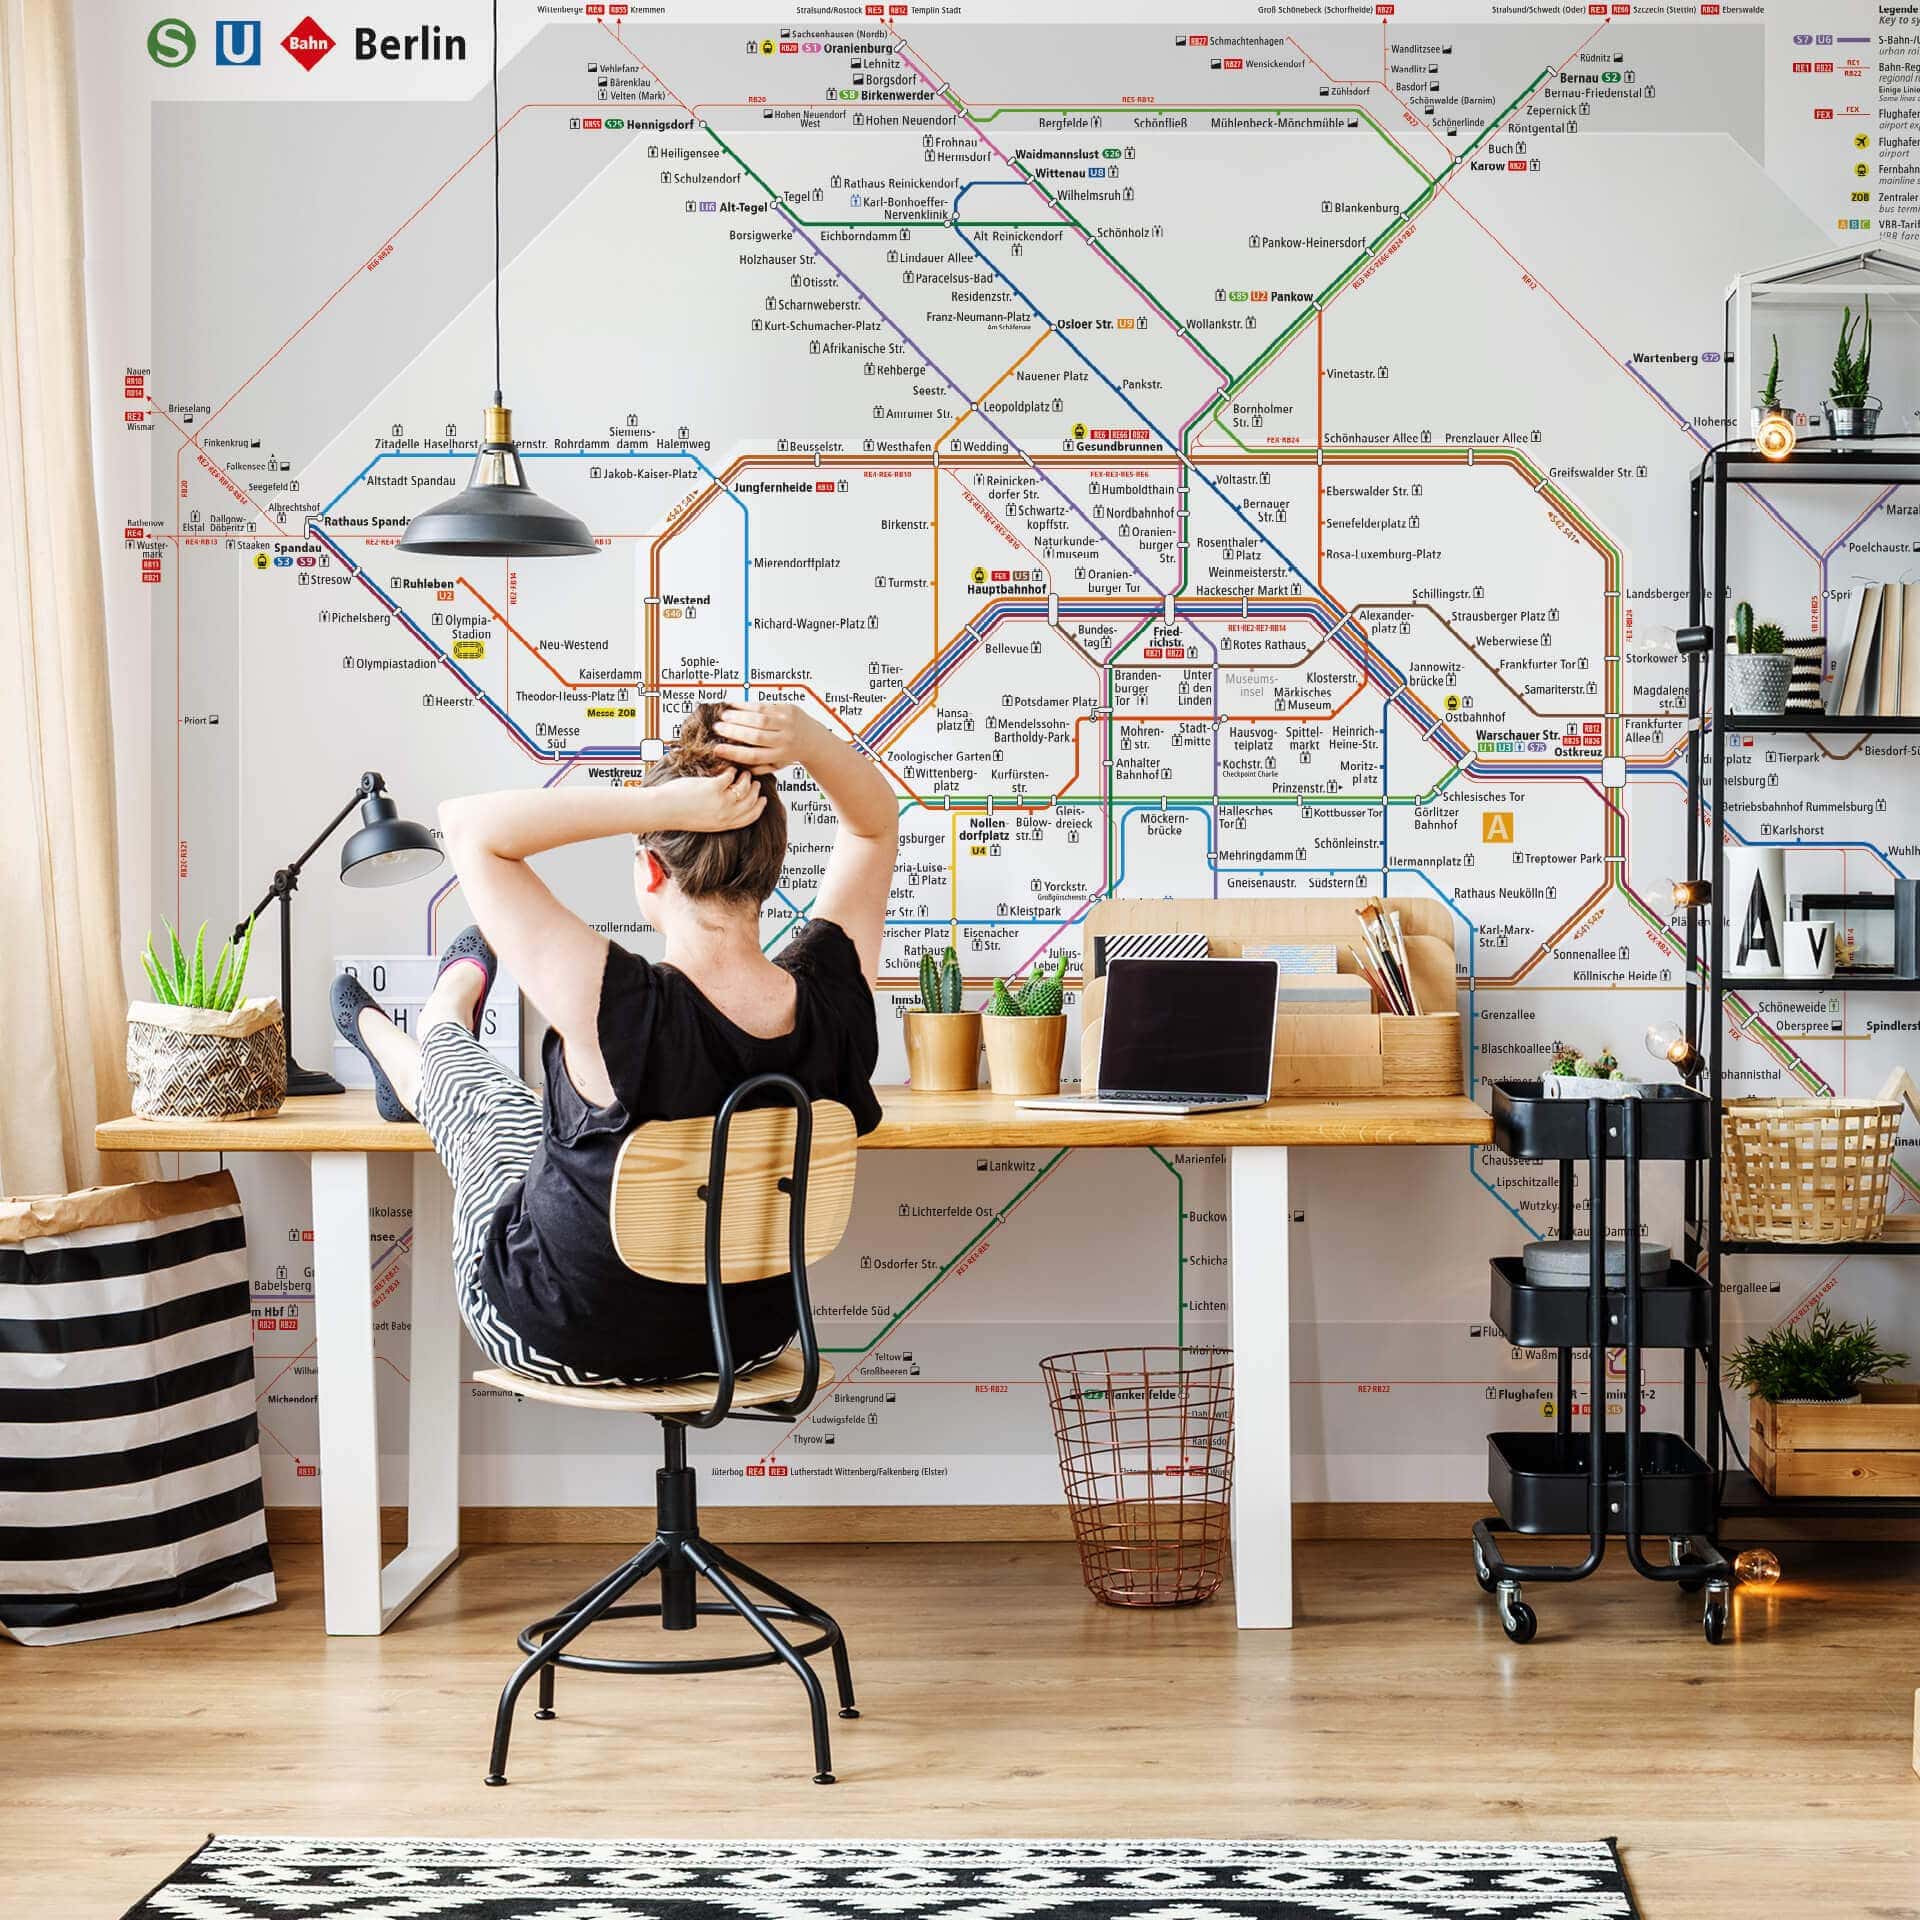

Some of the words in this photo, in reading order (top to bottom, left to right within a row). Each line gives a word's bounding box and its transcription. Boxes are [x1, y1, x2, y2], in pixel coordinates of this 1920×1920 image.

[1879, 5, 1918, 16] Legende
[157, 23, 188, 62] S
[222, 25, 254, 63] U
[290, 36, 328, 51] Bahn
[356, 25, 465, 60] Berlin
[824, 43, 892, 55] Oranienburg
[1392, 45, 1440, 53] Wandlitzsee
[864, 59, 900, 69] Lehnitz
[610, 78, 650, 87] Bärenklau
[867, 74, 916, 87] Borgsdorf
[1561, 73, 1598, 83] Bernau
[1396, 82, 1427, 91] Basdorf
[862, 90, 935, 100] Birkenwerder
[1545, 88, 1641, 98] Bernau-Friedenstal
[1527, 106, 1576, 117] Zepernick
[627, 119, 694, 132] Hennigsdorf
[1507, 123, 1564, 136] Röntgental
[936, 137, 977, 147] Frohnau
[661, 148, 719, 160] Heiligensee
[1489, 144, 1513, 154] Buch
[1879, 149, 1909, 159] airport
[1014, 149, 1099, 162] Waidmannslust
[1471, 161, 1505, 170] Karow
[674, 173, 741, 183] Schulzendorf
[1034, 168, 1085, 180] Wittenau
[782, 191, 810, 205] Tegel
[864, 197, 948, 207] Karl-Bonhoeffer-
[1056, 190, 1120, 203] Wilhelmsruh
[1852, 193, 1869, 201] ZOB
[720, 202, 767, 215] Alt-Tegel
[1335, 203, 1401, 217] Blankenburg
[885, 209, 951, 222] Nervenklinik
[730, 230, 794, 242] Borsigwerke
[821, 231, 897, 240] Eichborndamm
[1096, 227, 1149, 241] Schönholz
[1263, 237, 1368, 249] Pankow-Heinersdorf
[740, 255, 796, 264] Holzhauser
[800, 253, 817, 264] Str.
[952, 292, 1014, 301] Residenzstr.
[1272, 292, 1315, 303] Pankow
[779, 297, 863, 310] Scharnweberstr.
[927, 312, 1030, 321] Franz-Neumann-Platz
[765, 320, 883, 330] Kurt-Schumacher-Platz
[1055, 319, 1092, 331] Osloer
[1096, 320, 1113, 329] Str.
[1184, 319, 1242, 331] Wollankstr.
[1633, 353, 1698, 365] Wartenberg
[126, 368, 150, 377] Nauen
[1017, 371, 1060, 381] Nauener
[1064, 371, 1088, 380] Platz
[1123, 379, 1162, 389] Pankstr.
[913, 386, 946, 395] Seestr.
[169, 404, 210, 416] Brieselang
[982, 401, 1049, 415] Leopoldplatz
[202, 439, 248, 448] Finkenkrug
[1325, 433, 1390, 443] Schönhauser
[1393, 433, 1418, 443] Allee
[1446, 433, 1499, 443] Prenzlauer
[1503, 433, 1528, 443] Allee
[790, 442, 843, 454] Beusselstr.
[877, 441, 931, 451] Westhafen
[962, 439, 1010, 456] Wedding
[1077, 441, 1163, 451] Gesundbrunnen
[604, 468, 699, 478] Jakob-Kaiser-Platz
[1548, 467, 1614, 477] Greifswalder
[1618, 468, 1633, 477] Str.
[367, 476, 407, 486] Altstadt
[411, 476, 455, 485] Spandau
[732, 482, 812, 494] Jungfernheide
[1102, 485, 1174, 494] Humboldthain
[268, 503, 322, 514] Albrechtshof
[1107, 507, 1174, 518] Nordbahnhof
[1324, 518, 1406, 528] Senefelderplatz
[275, 541, 324, 557] Spandau
[1198, 537, 1260, 550] Rosenthaler
[311, 572, 353, 584] Stresow
[403, 578, 453, 588] Ruhleben
[968, 581, 1046, 596] Hauptbahnhof
[1412, 588, 1470, 602] Schillingstr.
[663, 595, 710, 607] Westend
[332, 610, 392, 626] Pichelsberg
[446, 615, 491, 628] Olympia-
[1452, 611, 1517, 624] Strausberger
[1521, 612, 1545, 621] Platz
[755, 618, 864, 632] Richard-Wagner-Platz
[452, 627, 490, 639] Stadion
[1154, 624, 1182, 640] Fried-
[540, 640, 608, 649] Neu-Westend
[1148, 637, 1184, 650] richstr.
[1476, 636, 1538, 646] Weberwiese
[986, 643, 1028, 653] Bellevue
[357, 655, 438, 671] Olympiastadion
[580, 669, 641, 679] Kaiserdamm
[662, 668, 739, 682] Charlotte-Platz
[751, 669, 812, 679] Bismarckstr.
[1307, 672, 1359, 683] Klosterstr.
[1522, 685, 1584, 696] Samariterstr.
[1015, 697, 1069, 706] Potsdamer
[1073, 696, 1099, 709] Platz
[588, 709, 614, 717] Messe
[618, 709, 635, 717] ZOB
[1446, 709, 1506, 722] Ostbahnhof
[548, 725, 579, 736] Messe
[999, 718, 1069, 732] Mendelssohn-
[995, 731, 1069, 743] Bartholdy-Park
[1476, 730, 1542, 743] Warschauer
[1541, 730, 1560, 743] Str.
[888, 751, 953, 764] Zoologischer
[957, 752, 991, 761] Garten
[1555, 747, 1604, 760] Ostkreuz
[589, 768, 642, 780] Westkreuz
[1441, 789, 1506, 801] Schlesisches
[1509, 792, 1525, 801] Tor
[970, 818, 1008, 831] Nollen-
[1487, 817, 1508, 839] A
[1773, 825, 1824, 835] Karlshorst
[959, 830, 1009, 843] dorfplatz
[1315, 837, 1381, 848] Schönleinstr.
[972, 847, 986, 855] U4
[1525, 854, 1577, 865] Treptower
[1581, 854, 1604, 863] Park
[1452, 888, 1495, 900] Rathaus
[1499, 888, 1543, 898] Neukölln
[1010, 906, 1061, 919] Kleistpark
[1736, 869, 1780, 967] A
[1554, 949, 1615, 959] Sonnenallee
[1807, 928, 1827, 969] V
[1757, 1001, 1826, 1012] Schöneweide
[1480, 1009, 1535, 1019] Grenzallee
[1776, 1021, 1829, 1034] Oberspree
[990, 1161, 1035, 1171] Lankwitz
[913, 1207, 971, 1216] Lichterfelde
[970, 1207, 994, 1216] Ost
[255, 1278, 311, 1294] Babelsberg
[835, 1394, 883, 1403] Birkengrund
[813, 1416, 865, 1425] Ludwigsfelde
[794, 1435, 823, 1445] Thyrow
[835, 1467, 919, 1476] Wittenberg/Falkenberg
